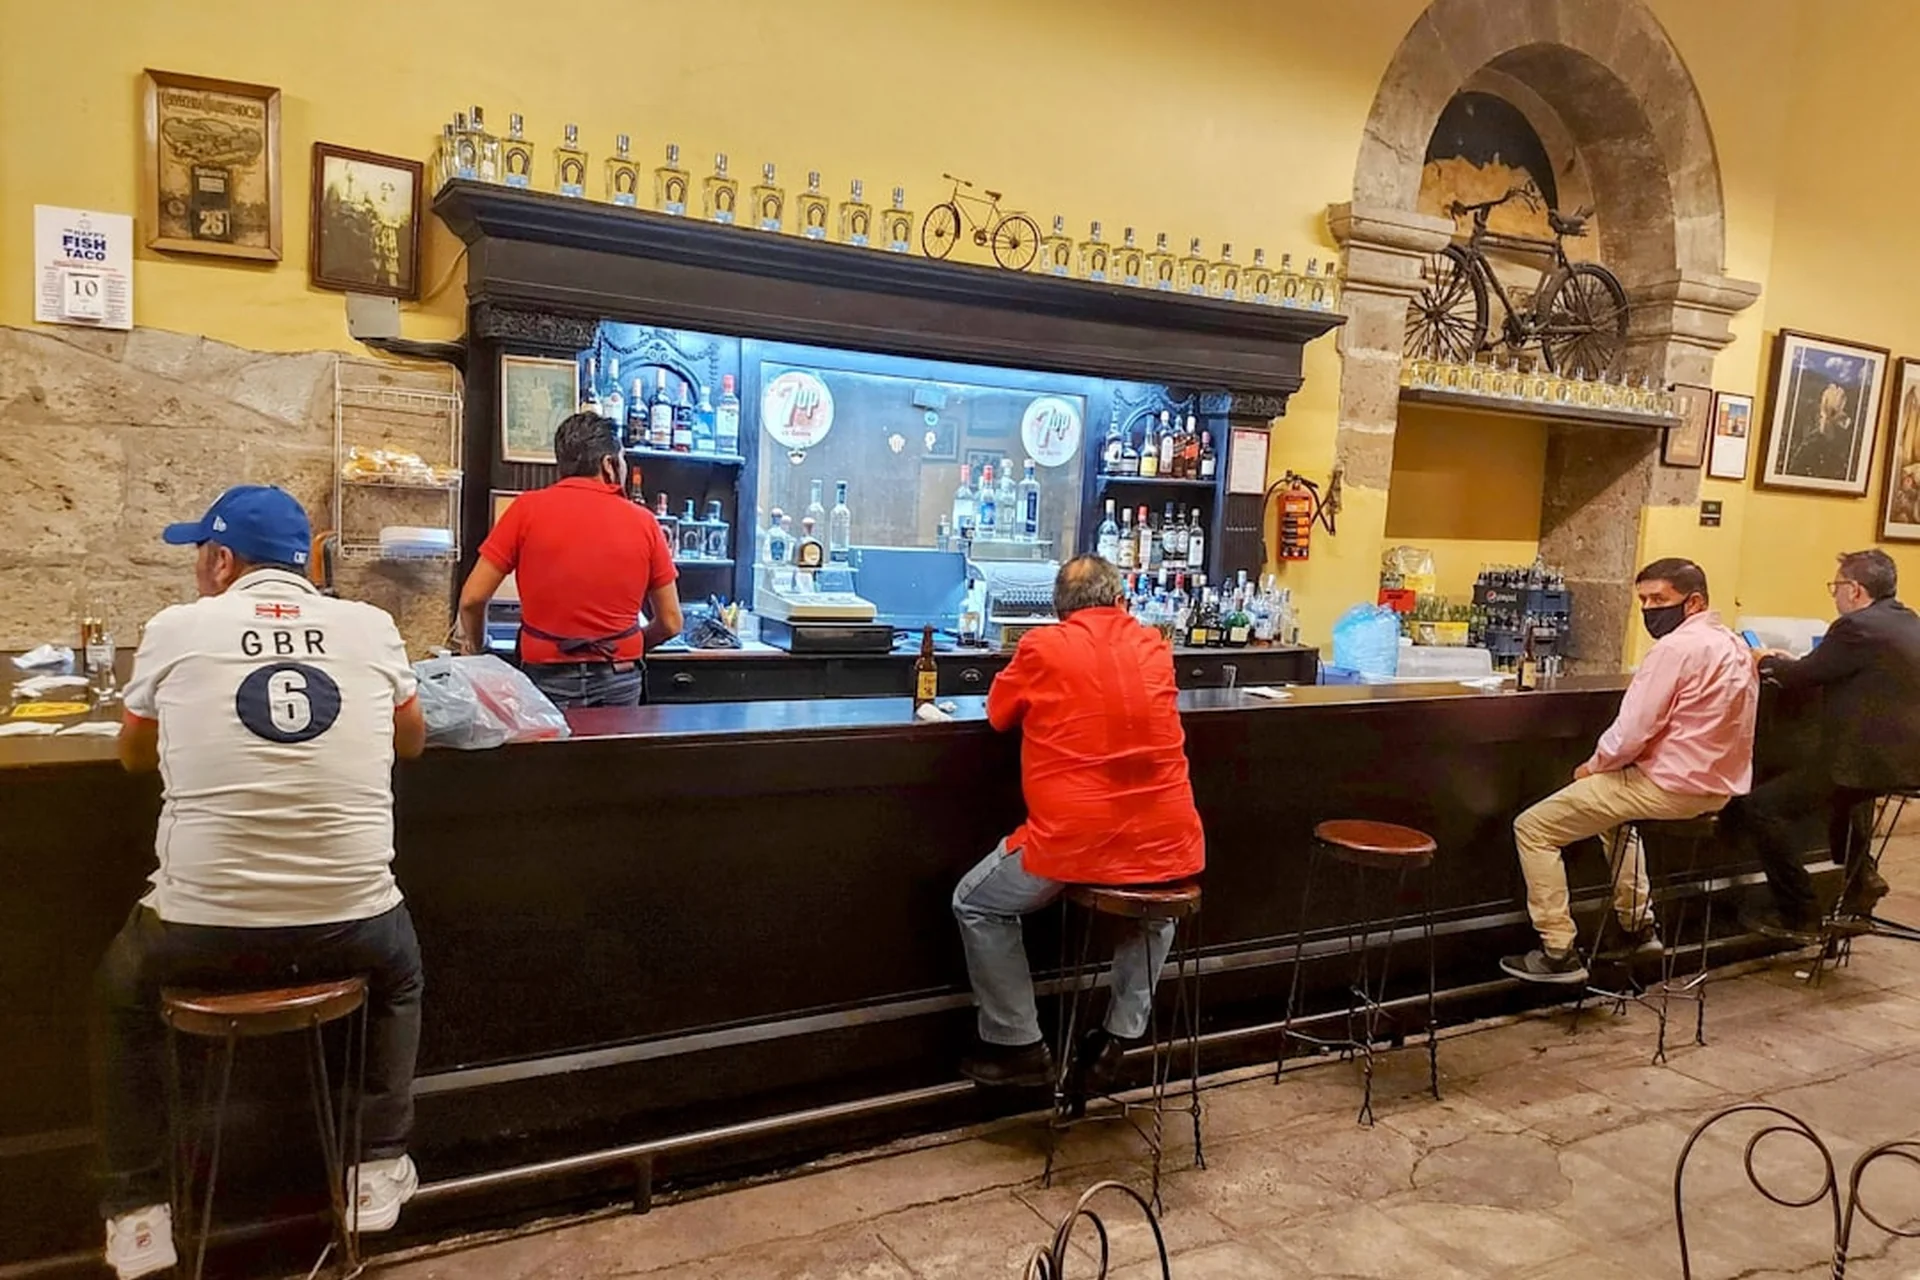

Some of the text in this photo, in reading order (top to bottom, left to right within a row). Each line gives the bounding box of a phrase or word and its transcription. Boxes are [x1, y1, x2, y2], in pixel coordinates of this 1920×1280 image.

[62, 235, 106, 251] FISH
[63, 248, 106, 261] TACO
[74, 280, 98, 297] 10
[241, 629, 326, 657] GBR
[267, 668, 312, 734] 6
